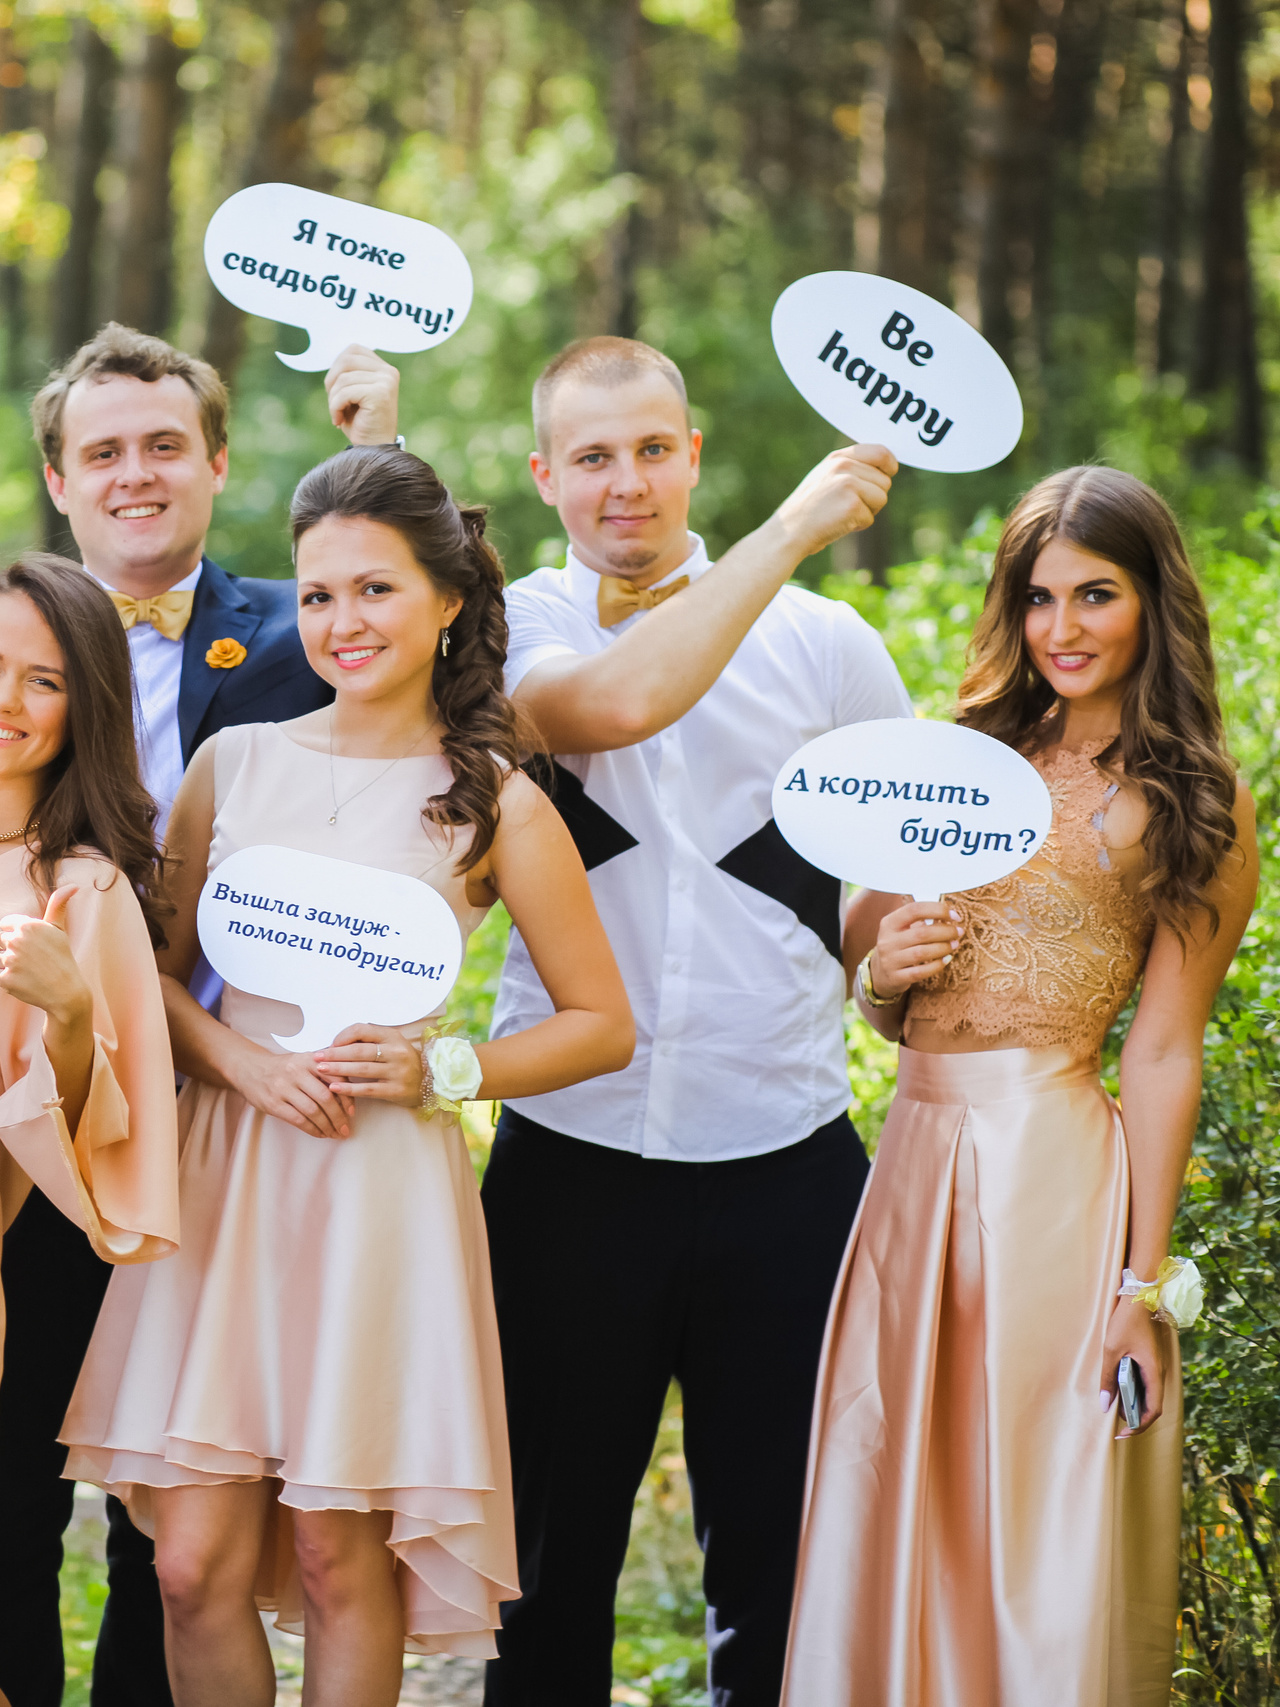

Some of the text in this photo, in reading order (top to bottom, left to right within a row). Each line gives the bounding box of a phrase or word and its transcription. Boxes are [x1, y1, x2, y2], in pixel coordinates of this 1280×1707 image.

[293, 219, 406, 270] Я тоже
[223, 252, 454, 335] свадьбу хочу!
[880, 310, 934, 366] Be
[817, 329, 954, 446] happy
[784, 768, 990, 807] А кормить
[900, 817, 1036, 856] будут?
[211, 882, 300, 918] Вышла
[304, 907, 390, 938] замуж
[227, 920, 445, 981] помоги подругам!
